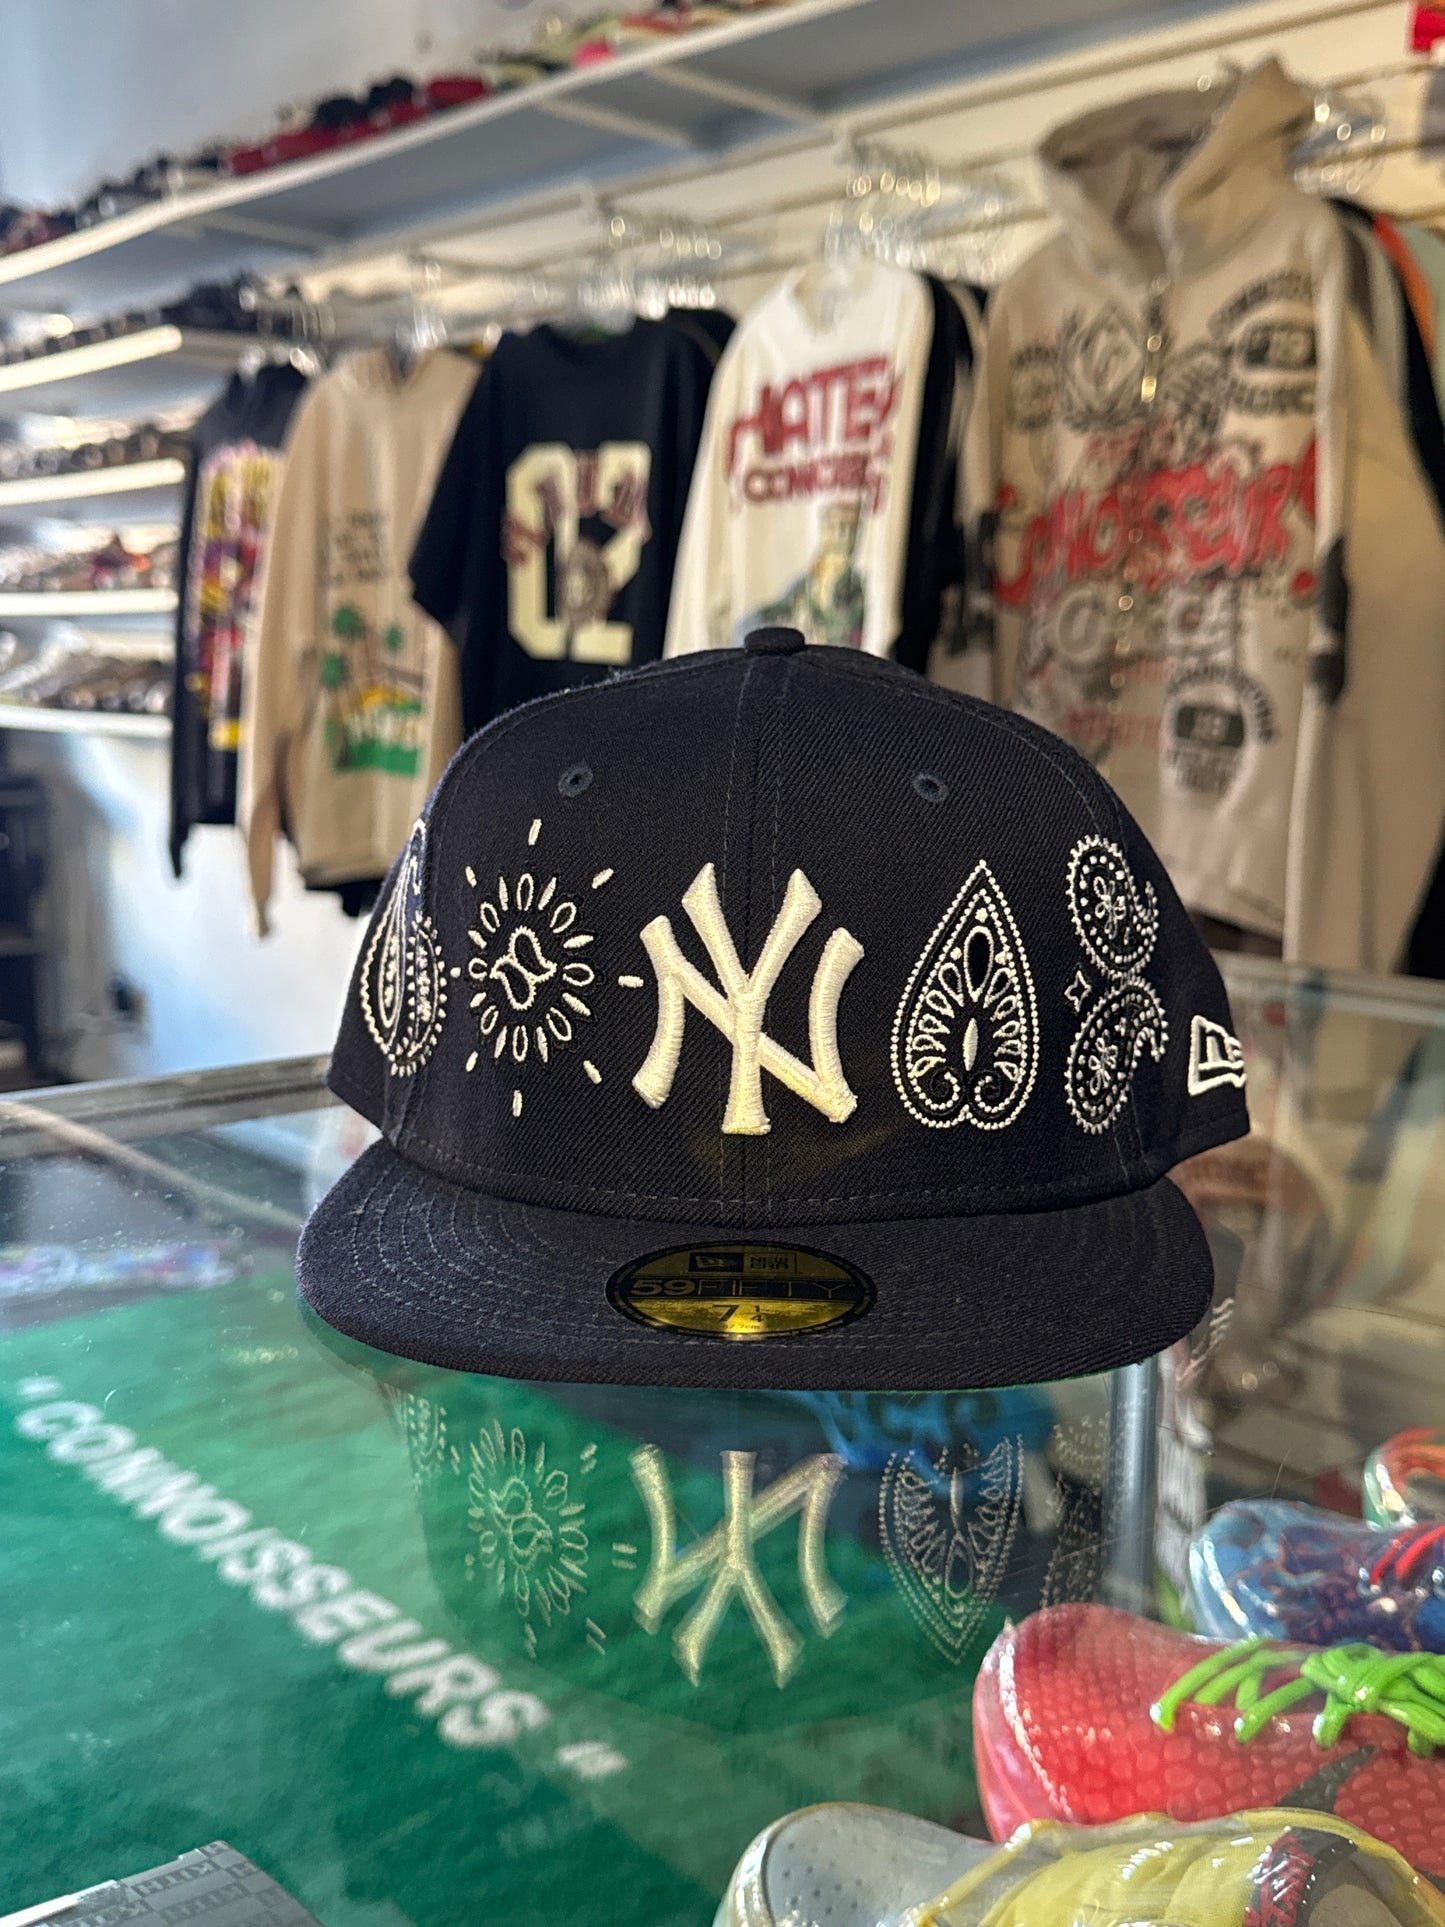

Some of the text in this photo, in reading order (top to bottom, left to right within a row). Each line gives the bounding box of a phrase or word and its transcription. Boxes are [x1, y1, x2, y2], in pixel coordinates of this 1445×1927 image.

[632, 862, 865, 1135] NY
[630, 1279, 847, 1299] 59FIFTY
[712, 1305, 739, 1321] 7
